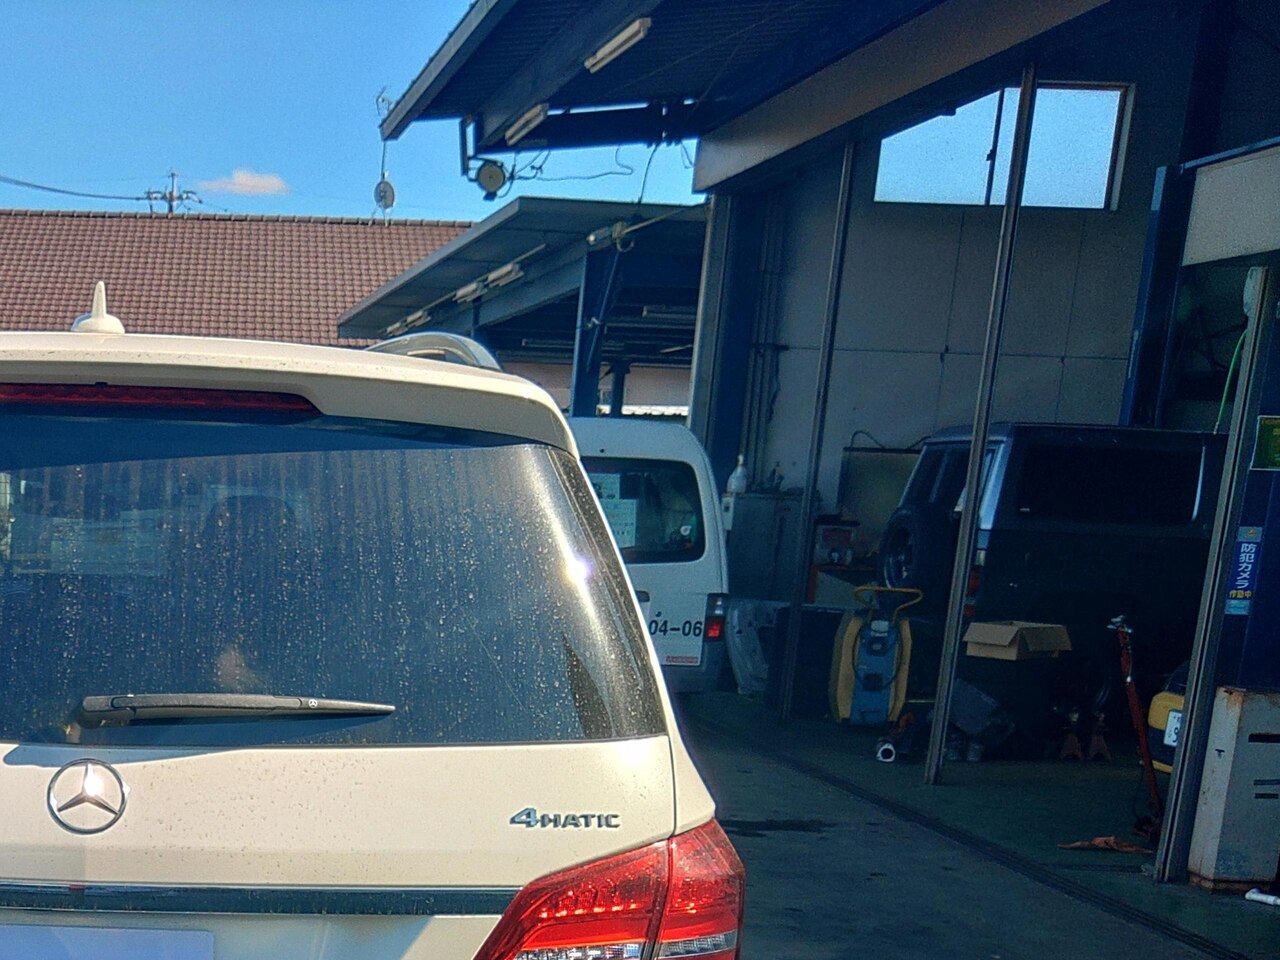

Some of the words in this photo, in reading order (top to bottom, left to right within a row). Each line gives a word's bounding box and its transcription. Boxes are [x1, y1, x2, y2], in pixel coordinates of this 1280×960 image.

[1235, 543, 1257, 589] 防犯カメラ
[649, 619, 703, 637] 04-06
